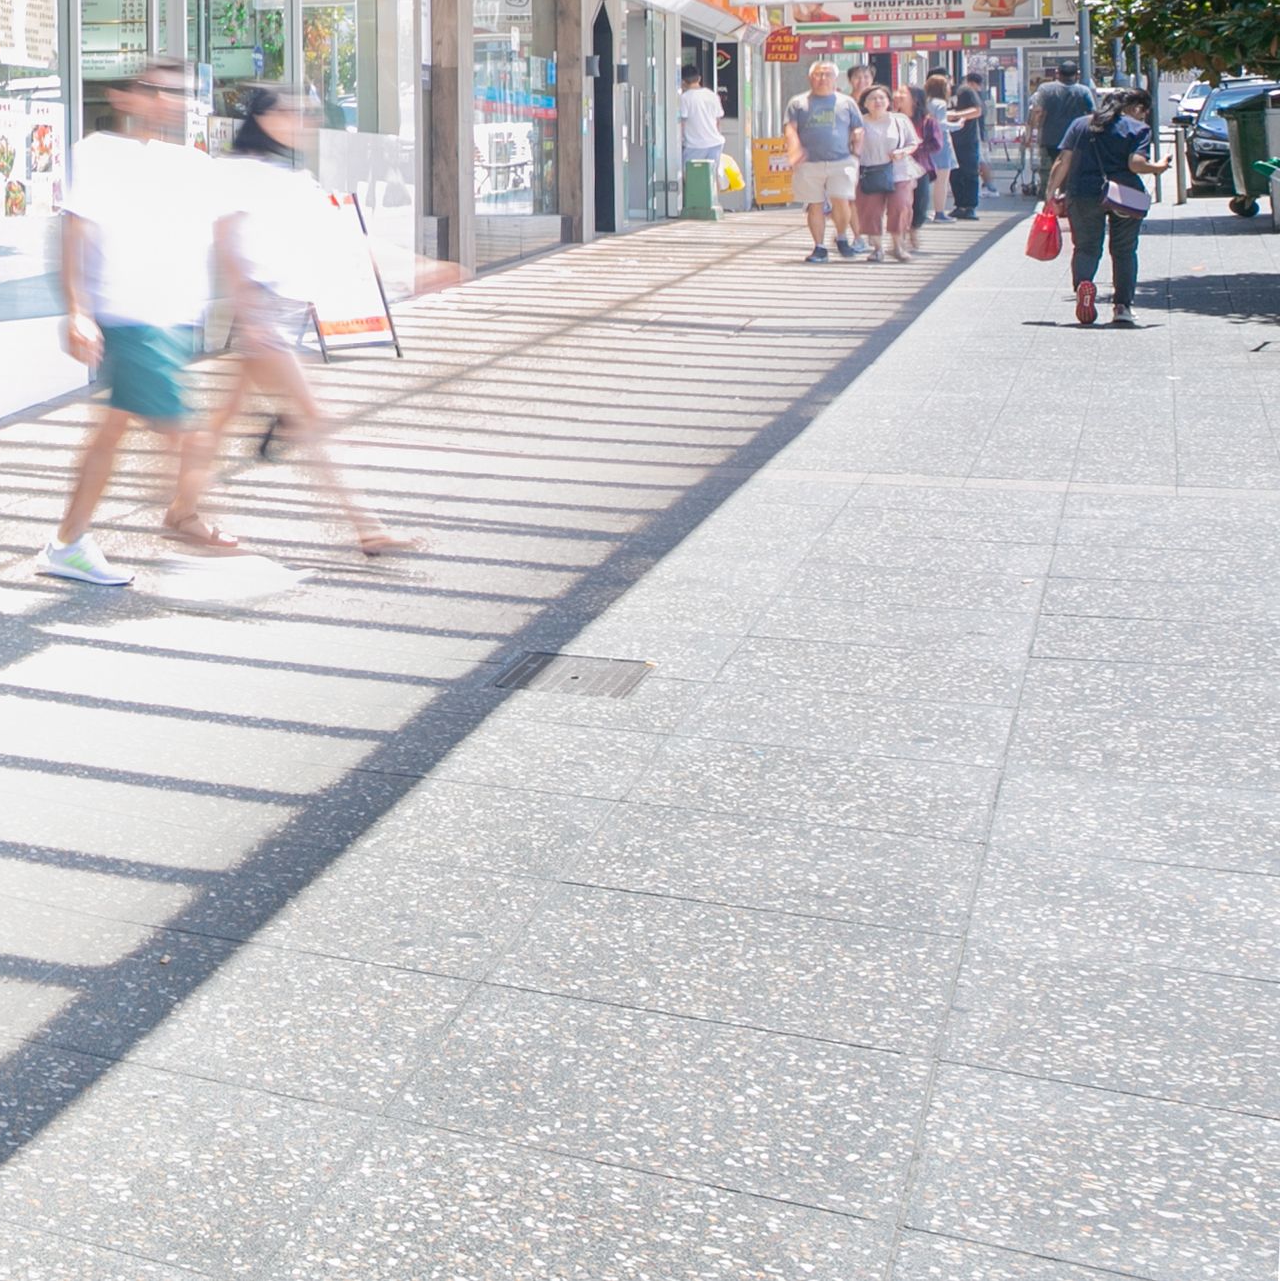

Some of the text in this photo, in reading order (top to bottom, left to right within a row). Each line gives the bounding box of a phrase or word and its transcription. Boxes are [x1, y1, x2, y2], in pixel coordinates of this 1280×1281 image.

[767, 35, 799, 43] CASH
[771, 44, 794, 52] FOR
[767, 53, 798, 61] GOLD
